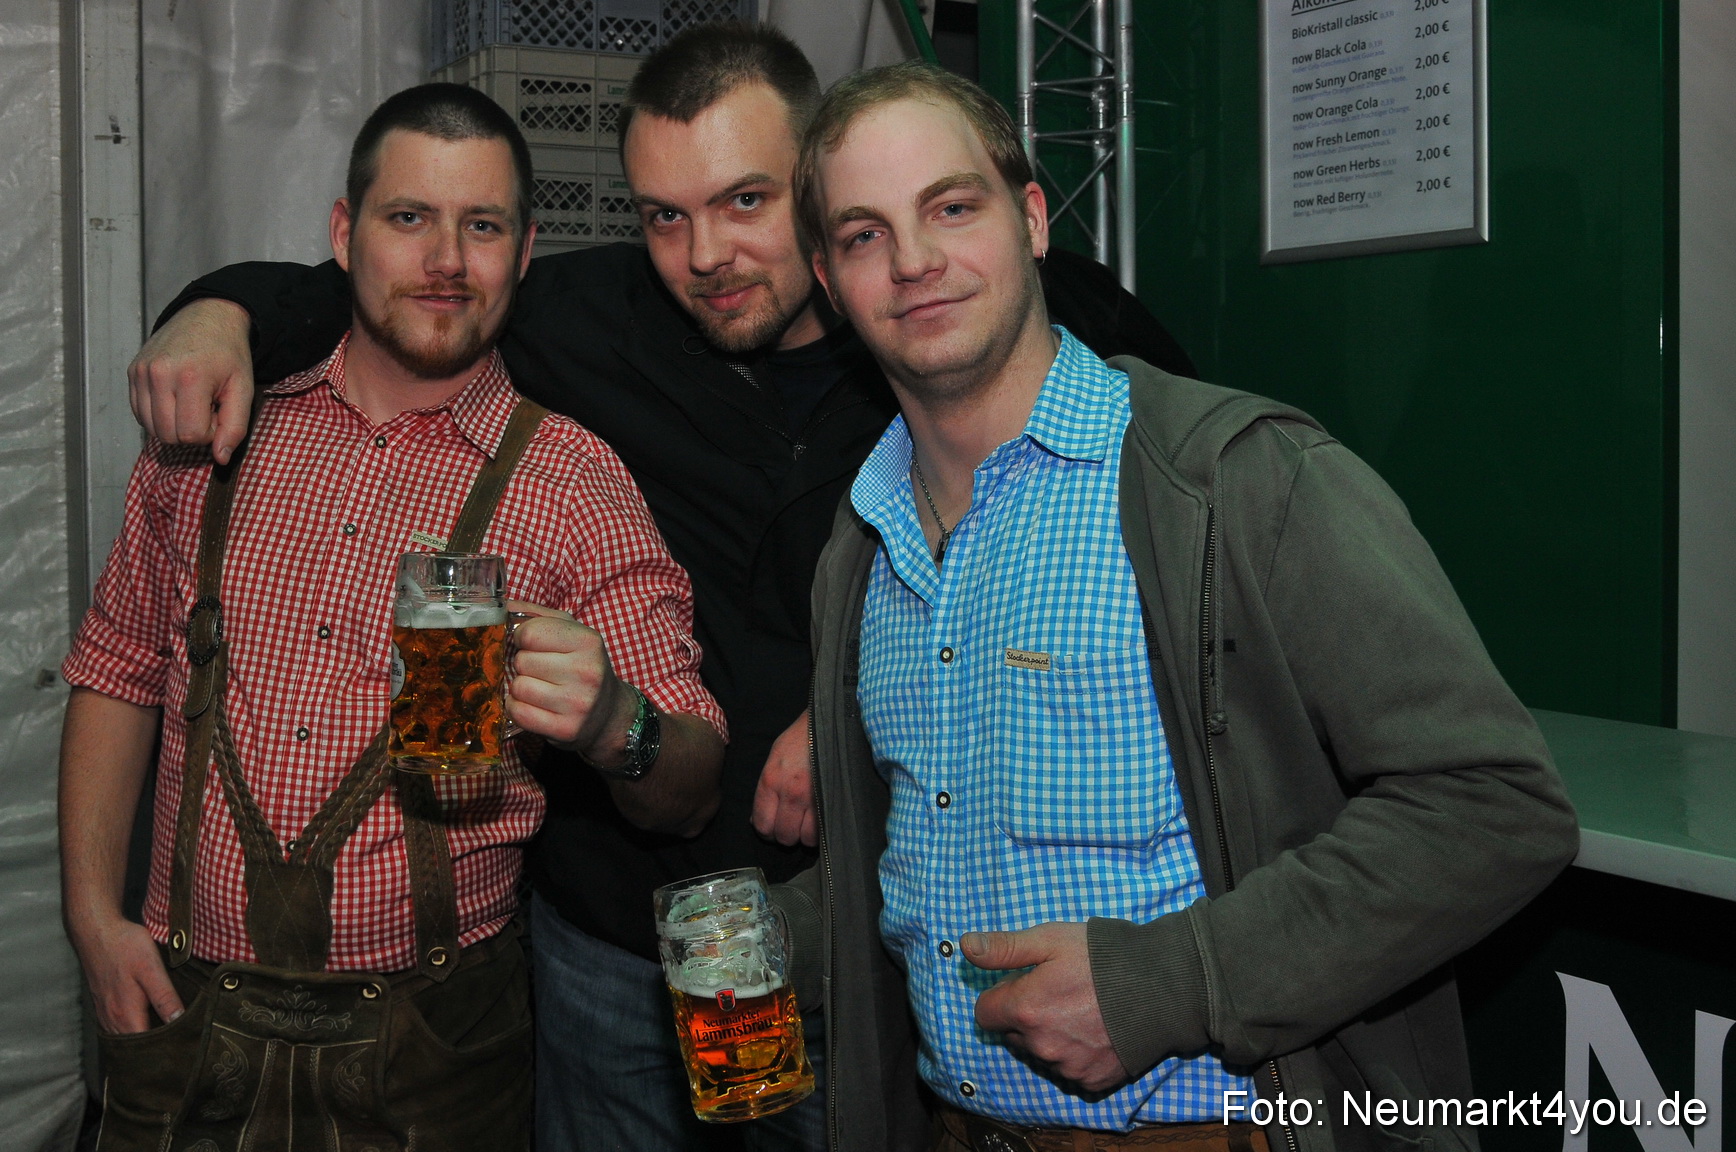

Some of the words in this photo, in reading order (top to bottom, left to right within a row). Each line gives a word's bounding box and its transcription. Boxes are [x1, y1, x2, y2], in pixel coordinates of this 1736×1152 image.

[1292, 17, 1343, 40] BioKristall
[1345, 10, 1379, 27] classic
[1414, 0, 1439, 11] 2,00
[1292, 54, 1312, 65] now
[1315, 47, 1341, 60] Black
[1344, 40, 1366, 53] Cola
[1415, 23, 1439, 38] 2,00
[1442, 20, 1449, 32] €
[1292, 83, 1313, 94] now
[1315, 75, 1346, 90] Sunny
[1348, 66, 1387, 82] Orange
[1415, 54, 1440, 69] 2,00
[1442, 51, 1450, 63] €
[1292, 111, 1313, 122] now
[1315, 103, 1353, 118] Orange
[1355, 97, 1378, 110] Cola
[1415, 85, 1440, 101] 2,00
[1442, 82, 1450, 94] €
[1293, 140, 1313, 151] now
[1316, 132, 1342, 146] Fresh
[1345, 128, 1380, 142] Lemon
[1416, 117, 1440, 132] 2,00
[1443, 114, 1450, 126] €
[1293, 169, 1314, 180] now
[1316, 162, 1347, 177] Green
[1349, 156, 1380, 171] Herbs
[1416, 147, 1440, 162] 2,00
[1443, 145, 1451, 157] €
[1293, 198, 1314, 209] now
[1317, 191, 1336, 205] Red
[1338, 189, 1366, 203] Berry
[1416, 178, 1440, 193] 2,00
[1443, 176, 1451, 188] €
[1006, 651, 1049, 666] Stockerpoint
[695, 1017, 773, 1042] Lammsbräu
[703, 1010, 760, 1028] Neumarkter
